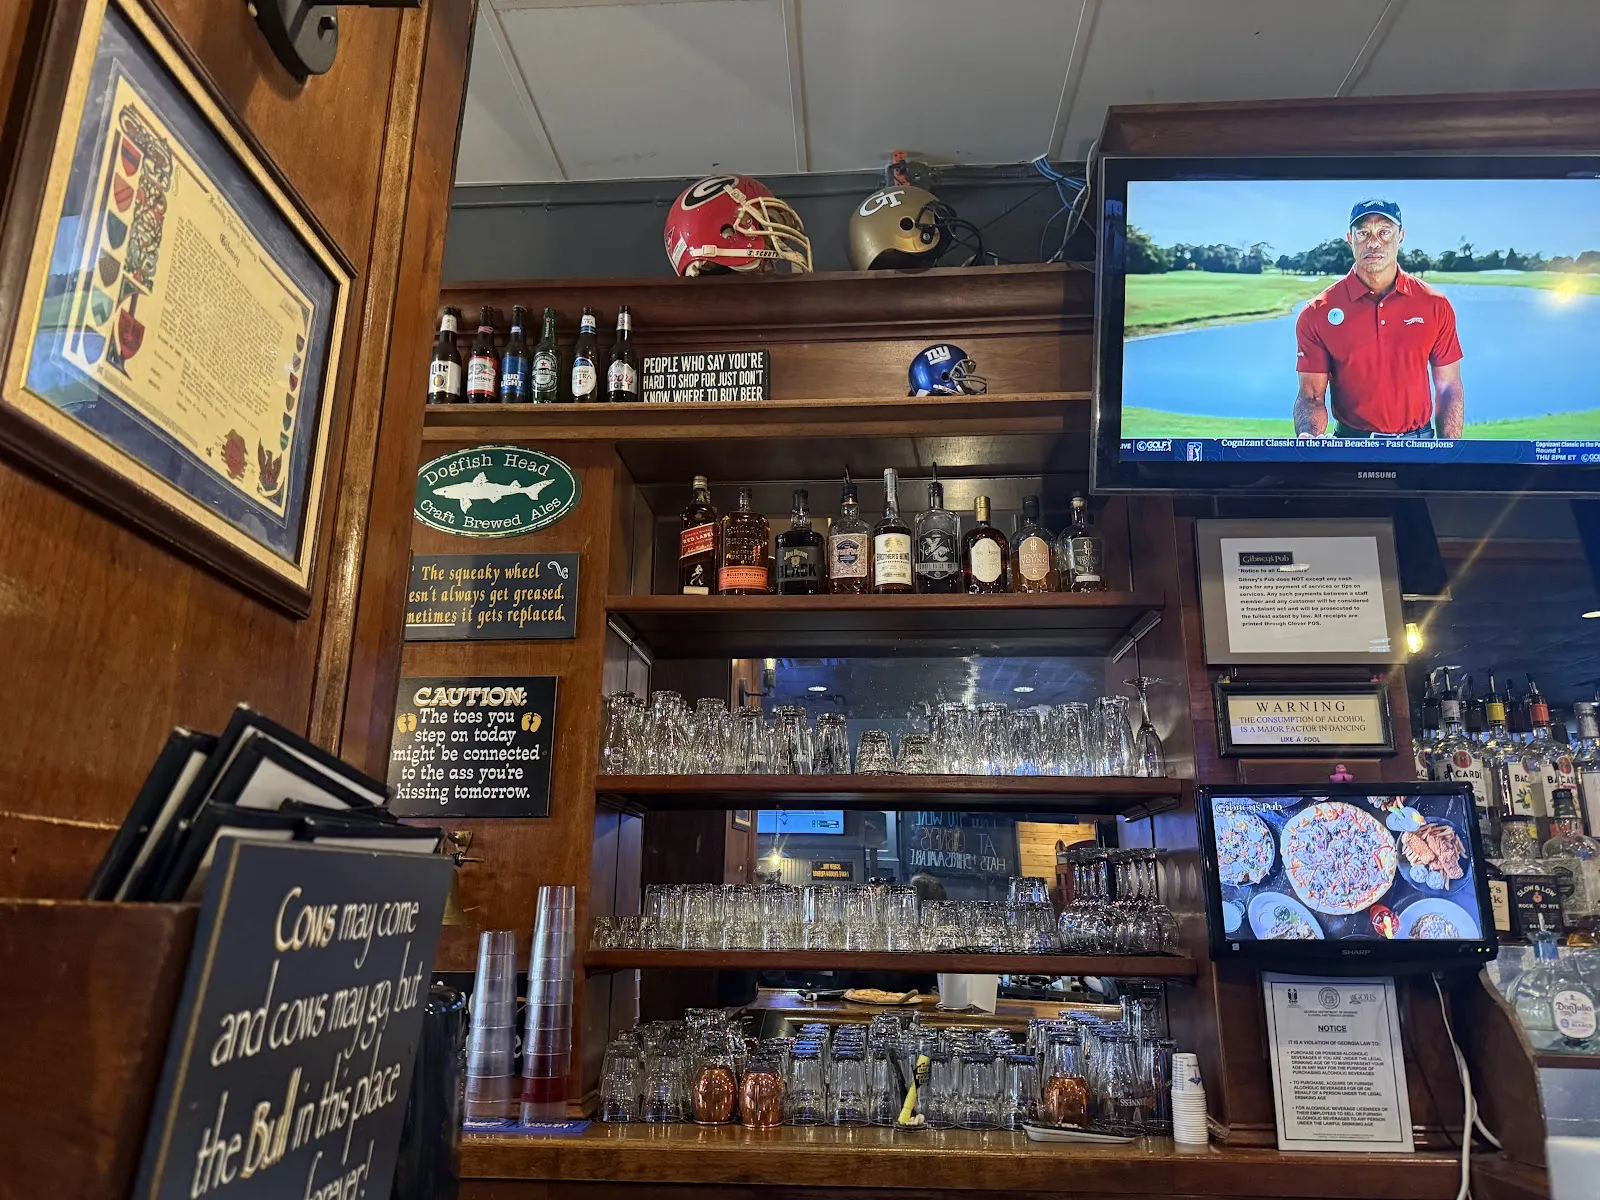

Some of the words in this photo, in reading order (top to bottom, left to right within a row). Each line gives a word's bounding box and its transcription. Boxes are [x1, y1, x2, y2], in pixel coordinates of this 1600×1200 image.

[643, 356, 679, 374] PEOPLE
[681, 355, 705, 372] WHO
[707, 354, 726, 371] SAY
[728, 352, 764, 370] YOU'RE
[643, 374, 665, 390] HARD
[666, 374, 677, 388] TO
[678, 373, 700, 388] SHOP
[700, 372, 716, 387] FOR
[717, 371, 738, 386] JUST
[739, 370, 764, 386] DON'T
[643, 390, 671, 403] KNOW
[672, 389, 704, 403] WHERE
[706, 388, 718, 402] TO
[720, 388, 739, 402] BUY
[740, 386, 763, 401] BEER
[1146, 440, 1166, 448] GOLF
[1221, 438, 1268, 448] Cognizant
[1268, 438, 1296, 447] Classic
[1296, 439, 1304, 447] in
[1322, 440, 1343, 448] Palm
[1345, 440, 1380, 448] Beaches
[1386, 440, 1405, 448] Past
[1406, 440, 1454, 449] Champions
[422, 454, 493, 486] Dogfish
[504, 454, 550, 477] Head
[1357, 471, 1397, 479] SAMSUNG
[420, 500, 456, 524] Craft
[462, 514, 522, 529] Brewed
[530, 497, 562, 521] Ales
[422, 563, 445, 581] The
[449, 562, 500, 586] squeaky
[504, 562, 540, 580] wheel
[408, 586, 437, 603] esn't
[440, 585, 486, 607] always
[488, 588, 509, 607] get
[513, 583, 564, 607] greased.
[406, 608, 458, 624] metimes
[462, 608, 473, 623] it
[476, 609, 503, 628] gets
[507, 604, 566, 628] replaced.
[413, 686, 528, 707] CAUTION:
[1256, 701, 1346, 712] WARNING
[419, 708, 448, 724] The
[453, 710, 483, 724] toes
[487, 711, 515, 728] you
[1239, 716, 1255, 724] THE
[1327, 715, 1365, 723] ALCOHOL
[1329, 724, 1366, 732] DANCING
[414, 729, 446, 748] step
[450, 731, 469, 742] on
[474, 726, 516, 746] today
[392, 745, 436, 766] might
[441, 745, 458, 760] be
[463, 744, 540, 761] connected
[401, 766, 416, 780] to
[420, 764, 445, 780] the
[449, 768, 474, 780] ass
[478, 763, 524, 784] you're
[396, 783, 450, 805] kissing
[454, 785, 530, 799] tomorrow.
[1262, 802, 1282, 812] Pub
[1517, 885, 1533, 897] SLOW
[1542, 886, 1556, 897] LOW
[274, 886, 338, 952] Cows
[338, 902, 378, 970] may
[377, 901, 419, 938] come
[210, 959, 280, 1067] and
[269, 991, 329, 1050] cows
[328, 984, 370, 1060] may
[360, 980, 392, 1051] go,
[393, 941, 424, 1013] but
[190, 1090, 242, 1199] the
[240, 1066, 303, 1178] Bull
[291, 1081, 315, 1150] in
[314, 1052, 352, 1140] this
[342, 1032, 401, 1166] place
